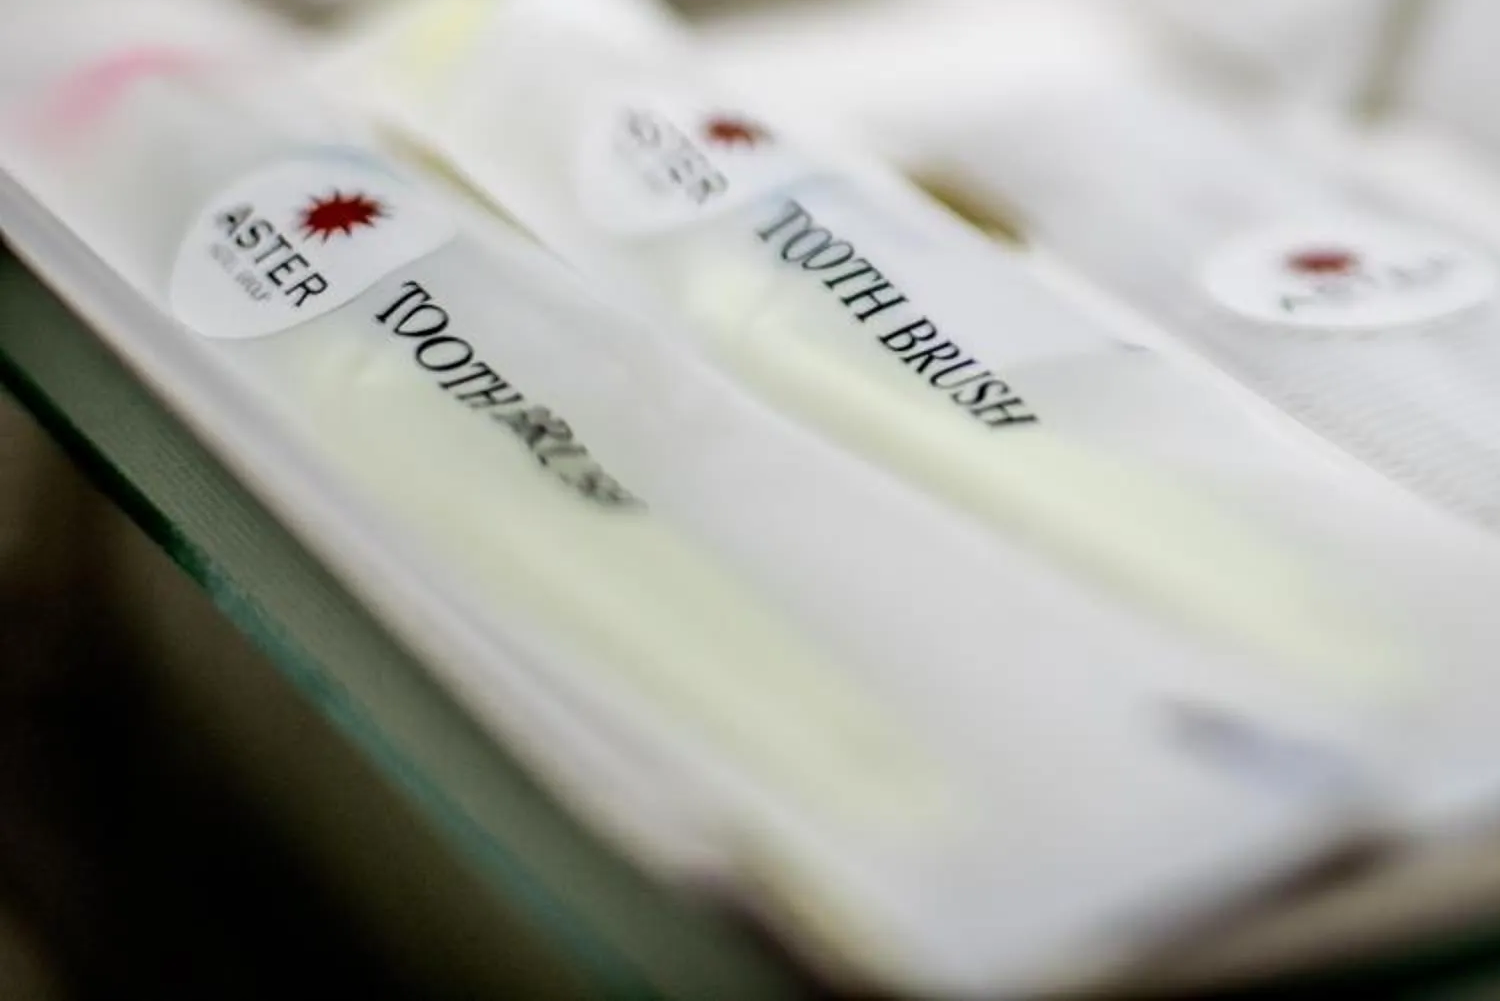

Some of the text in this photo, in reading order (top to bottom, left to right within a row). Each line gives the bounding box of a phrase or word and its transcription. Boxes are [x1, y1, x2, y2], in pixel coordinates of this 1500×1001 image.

[213, 202, 329, 309] ASTER
[755, 196, 1040, 431] TOOTH BRUSH
[374, 280, 523, 410] TOOTH
